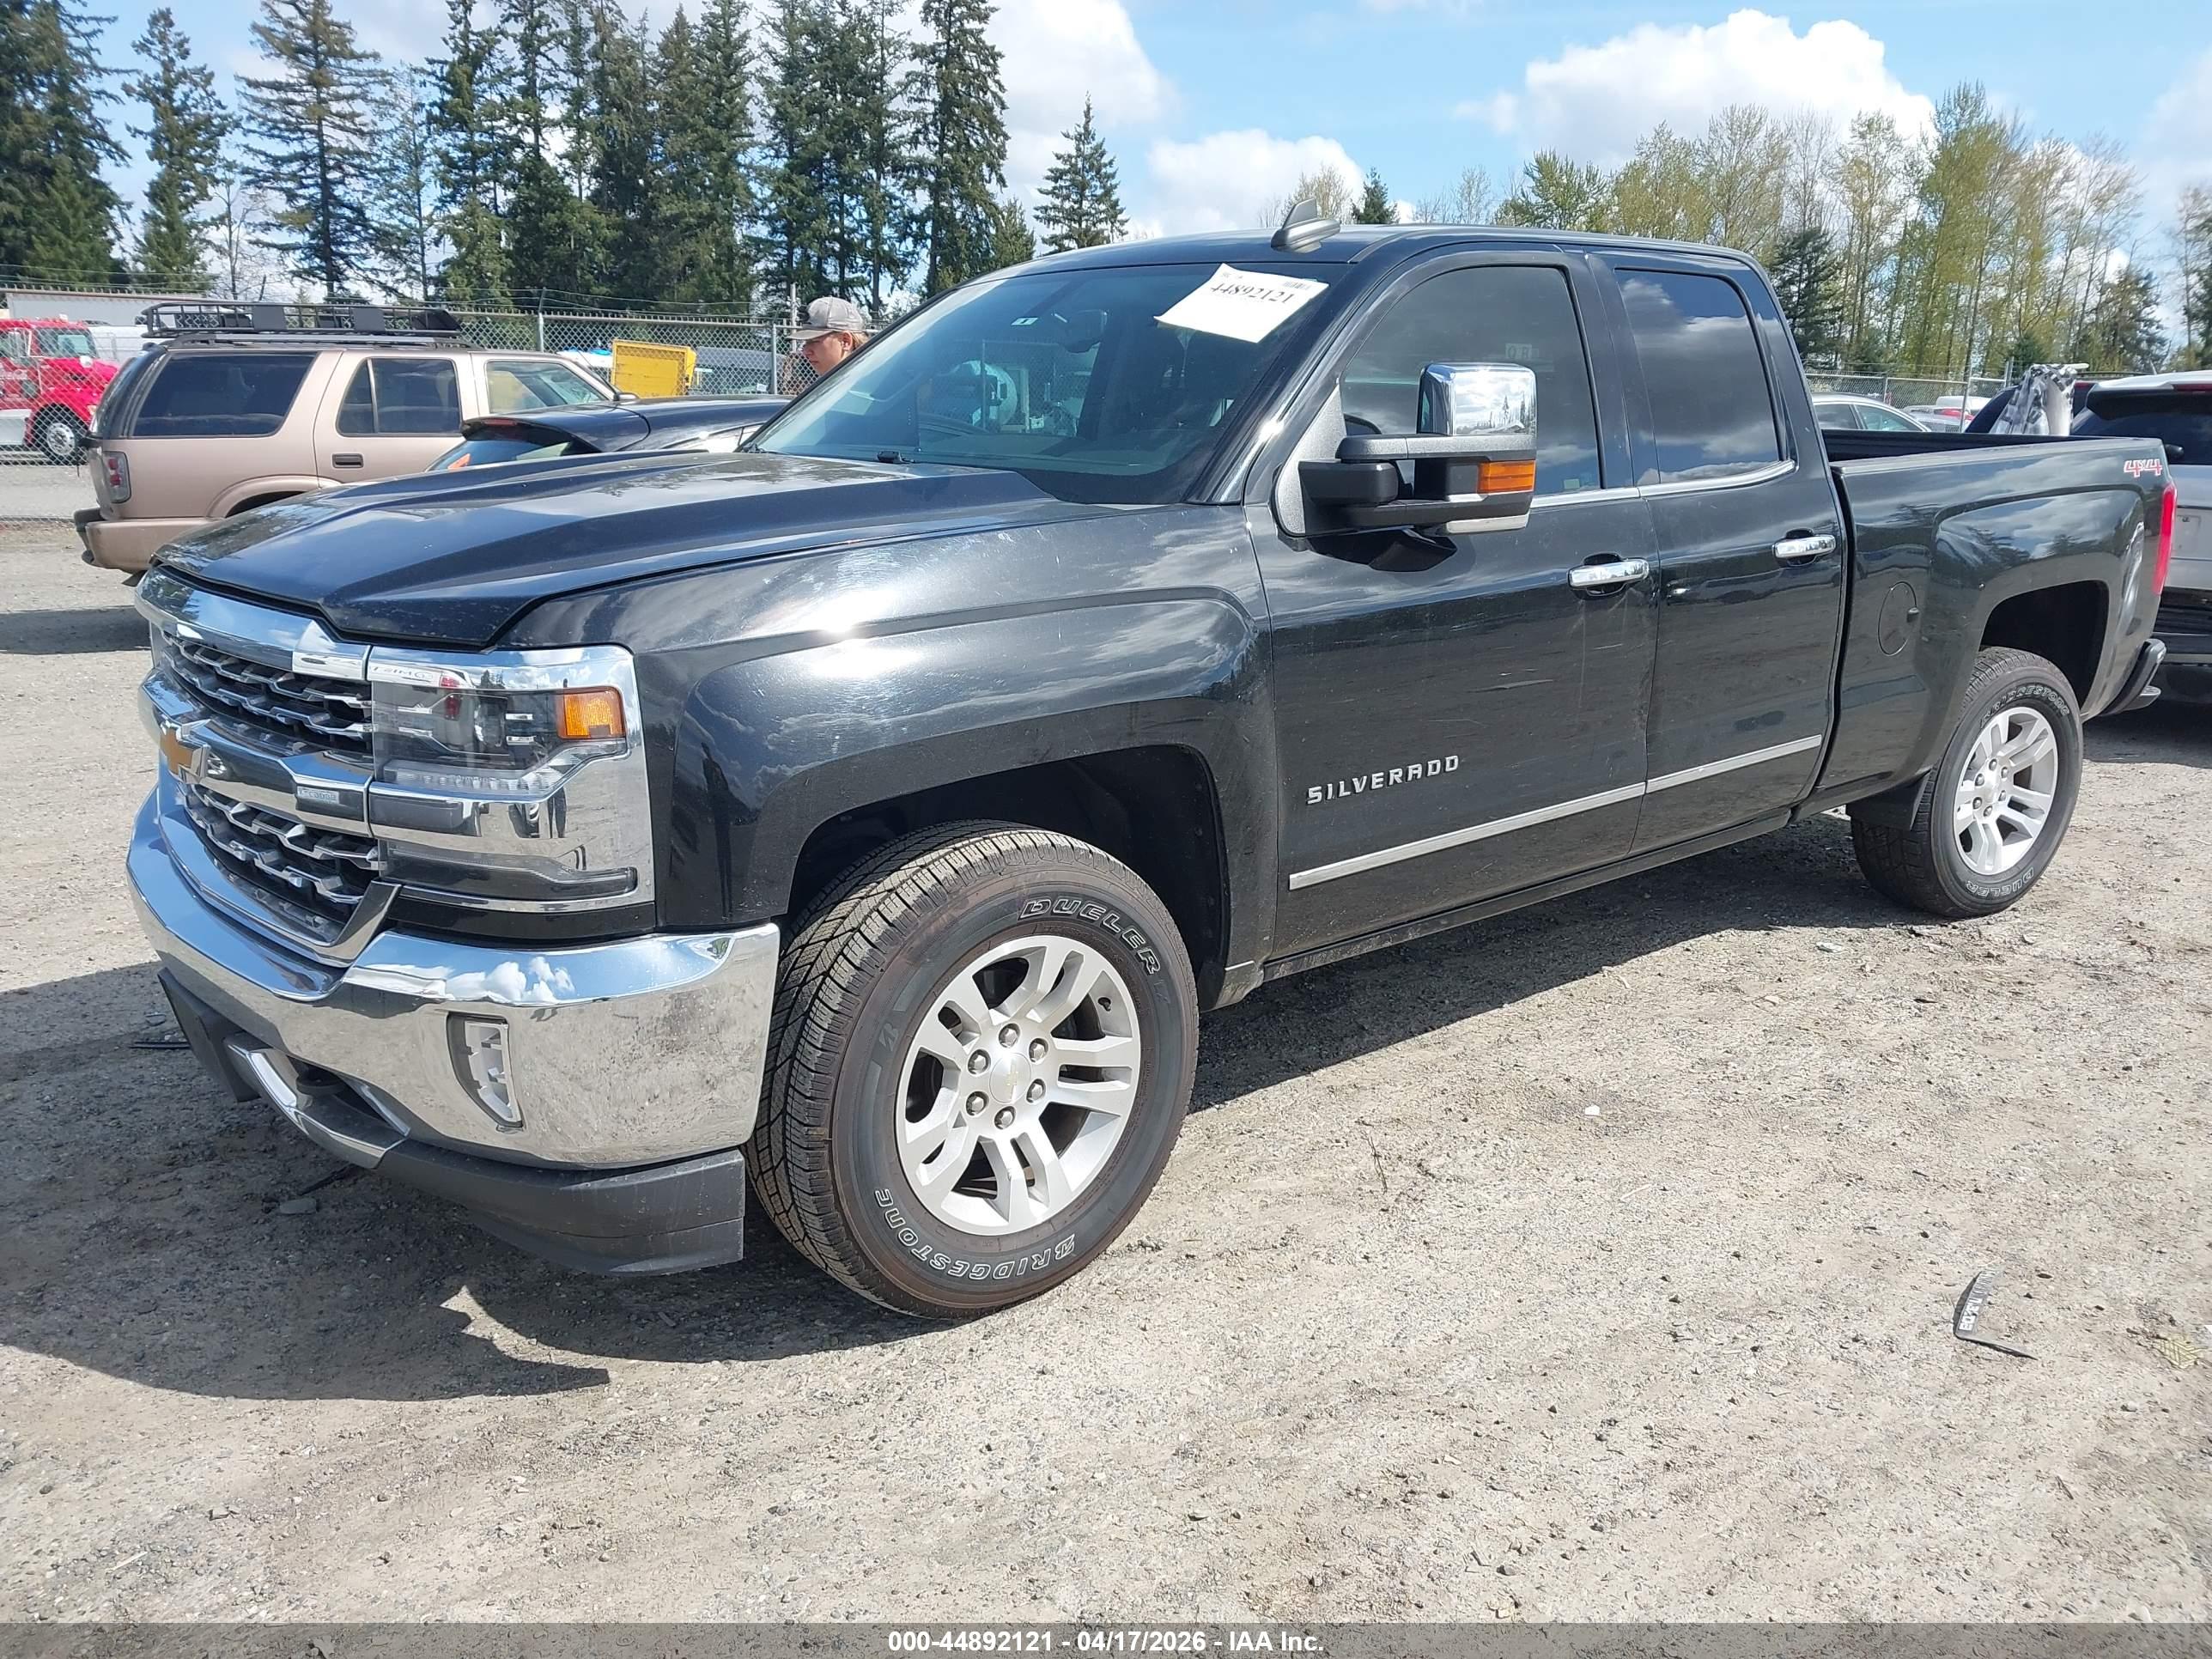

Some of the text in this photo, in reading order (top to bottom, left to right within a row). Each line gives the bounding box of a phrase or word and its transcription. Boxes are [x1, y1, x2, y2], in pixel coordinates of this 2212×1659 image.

[1211, 282, 1295, 304] 44892121
[1306, 755, 1460, 805] SILVERADO
[1965, 866, 2035, 897] DUELER
[1018, 896, 1162, 975] DUELER
[874, 1188, 1077, 1280] BRIDGESTONE
